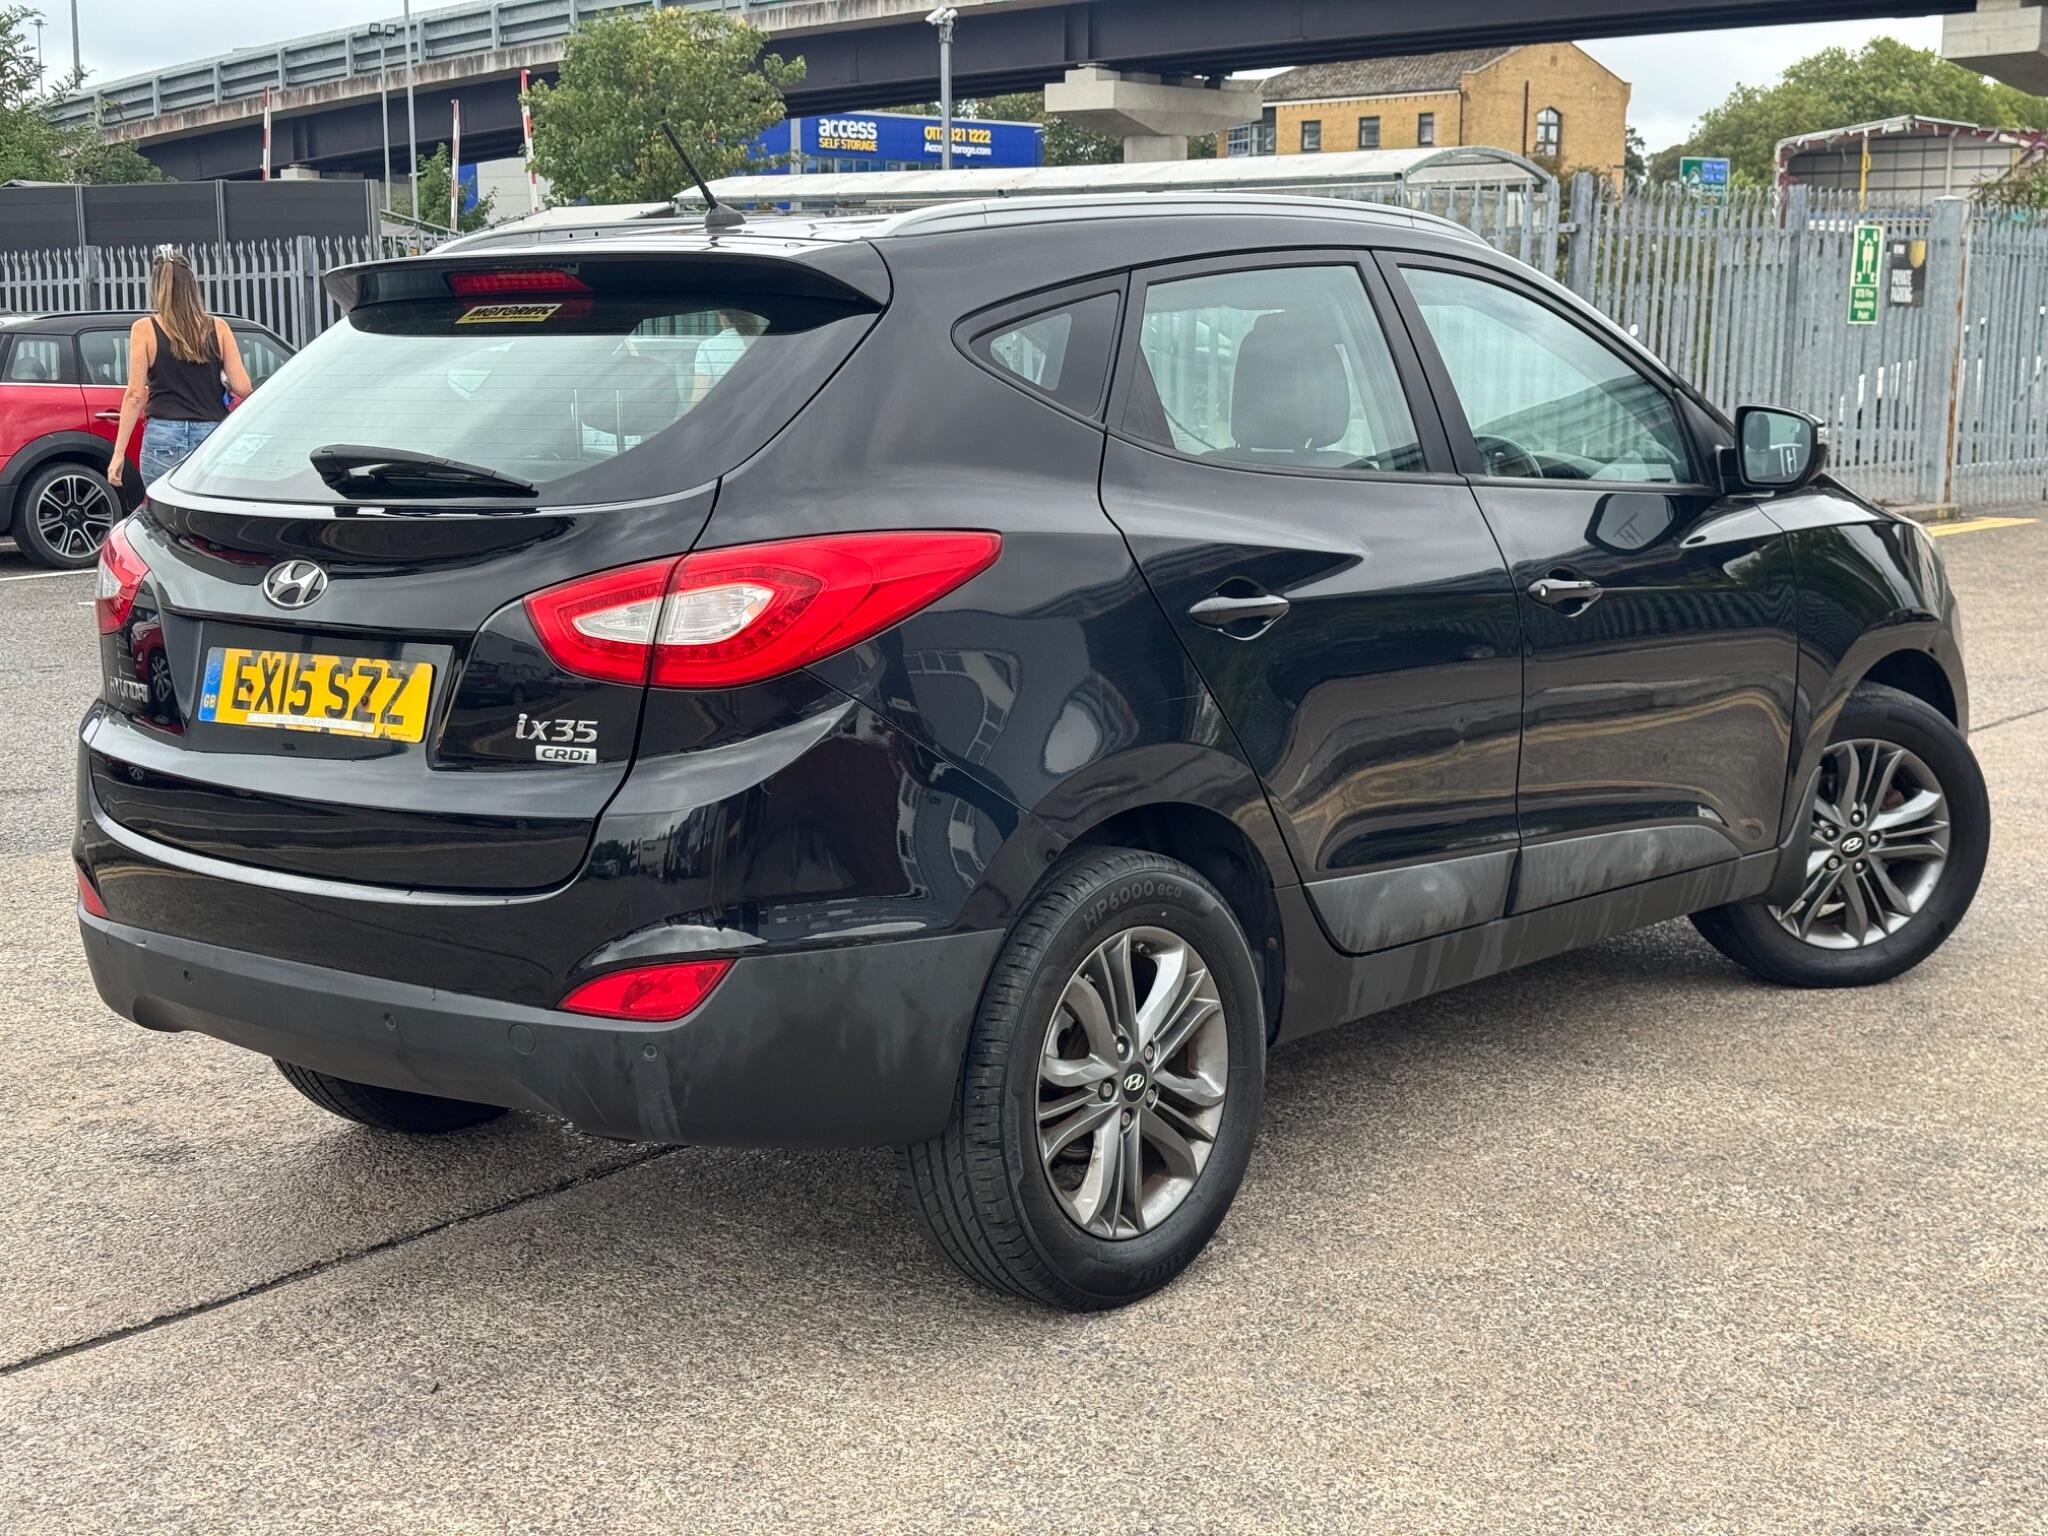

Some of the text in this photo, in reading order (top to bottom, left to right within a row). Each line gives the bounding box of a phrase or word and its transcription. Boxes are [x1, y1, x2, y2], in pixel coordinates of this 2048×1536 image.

[819, 119, 878, 139] access
[967, 129, 991, 144] 1222
[819, 138, 878, 152] SELF STORAGE
[467, 306, 557, 317] MOTORIFIC
[231, 656, 410, 726] EX15 SZZ
[202, 694, 216, 708] GB
[515, 713, 599, 743] ix35
[541, 748, 590, 762] CRDi
[1083, 880, 1182, 931] HP6000 eco
